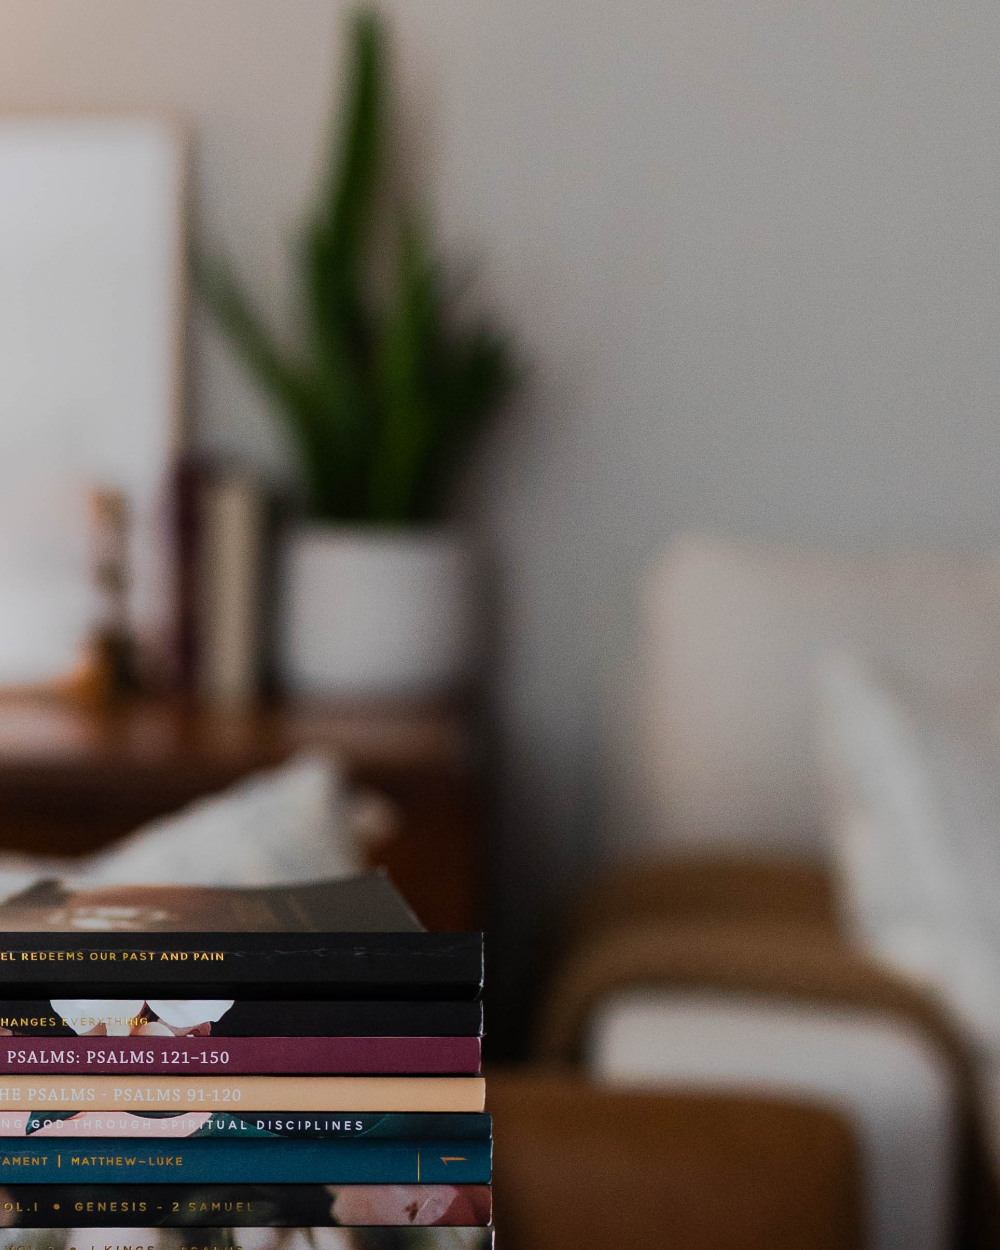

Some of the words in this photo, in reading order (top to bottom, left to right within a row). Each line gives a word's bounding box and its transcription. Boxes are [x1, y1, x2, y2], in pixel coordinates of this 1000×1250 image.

[21, 951, 84, 961] REDEEMS
[89, 951, 117, 961] OUR
[122, 951, 155, 961] PAST
[160, 952, 188, 961] AND
[193, 952, 224, 961] PAIN
[7, 1050, 81, 1064] PSALMS:
[86, 1050, 155, 1064] PSALMS
[27, 1088, 96, 1101] PSALMS
[113, 1088, 181, 1101] PSALMS
[187, 1089, 241, 1102] 91-120
[31, 1120, 65, 1130] GOD
[73, 1120, 151, 1130] THROUGH
[160, 1120, 248, 1130] SPIRITUAL
[256, 1120, 364, 1131] DISCIPLINES
[440, 1156, 468, 1166] 1
[74, 1202, 147, 1212] GENESIS
[172, 1202, 180, 1212] 2
[188, 1202, 253, 1212] SAMUEL
